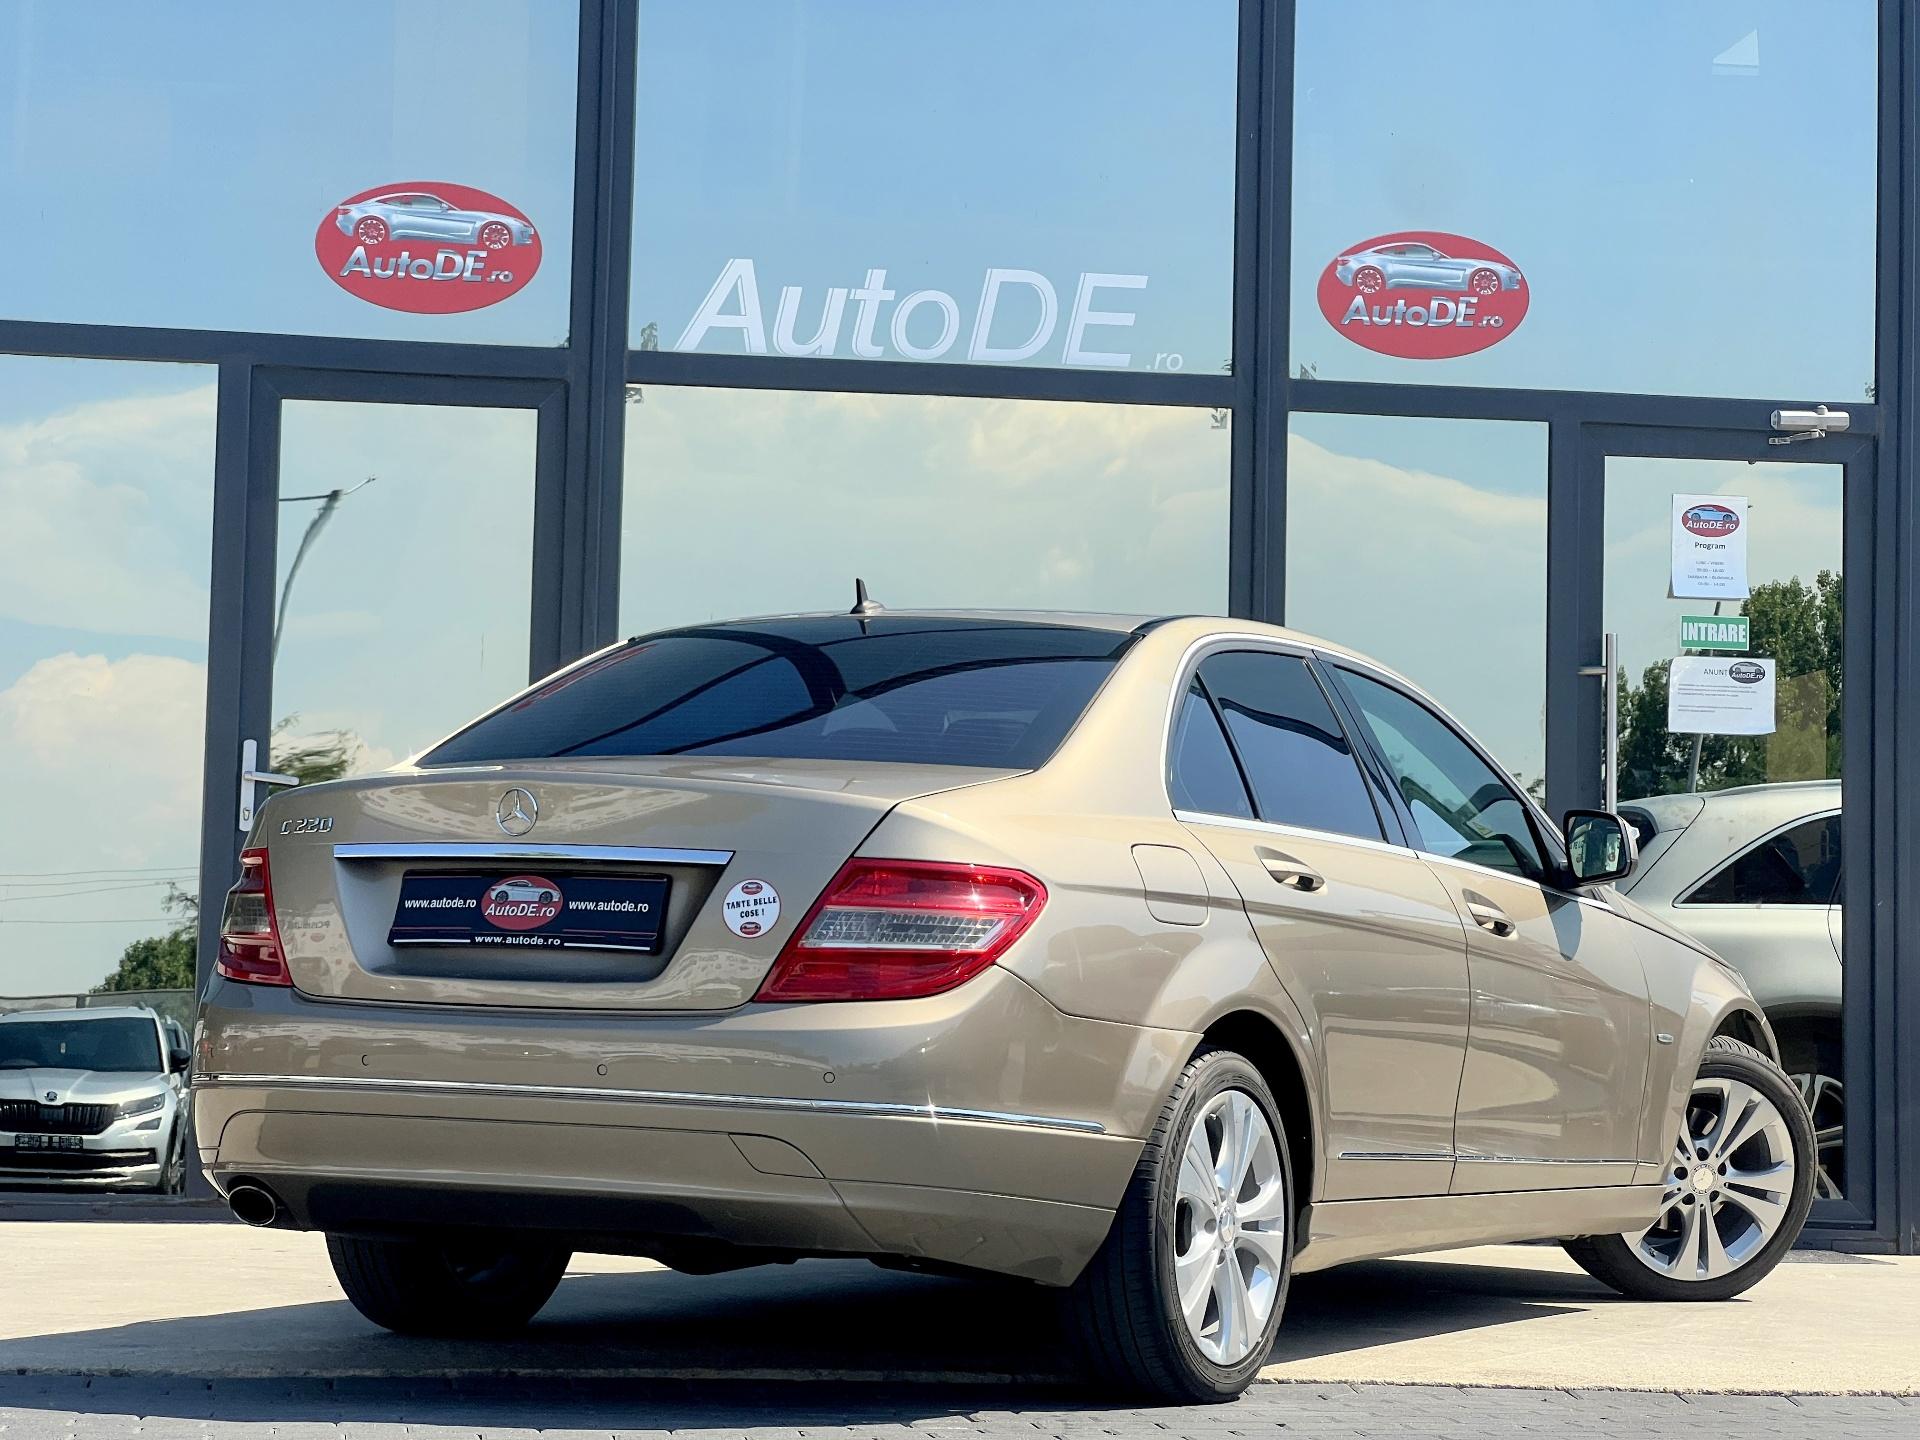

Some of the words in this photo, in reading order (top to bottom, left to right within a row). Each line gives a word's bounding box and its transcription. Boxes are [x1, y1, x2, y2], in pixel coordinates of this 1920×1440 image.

[1685, 520, 1736, 530] AutoDE.ro
[1694, 541, 1726, 551] Program
[1682, 622, 1746, 642] INTRARE
[280, 819, 293, 835] C
[293, 817, 333, 833] 220
[404, 897, 477, 909] www.autode.ro
[568, 899, 649, 913] www.autode.ro
[726, 900, 751, 910] TANTE
[753, 897, 777, 906] BELLE
[484, 903, 556, 917] AutoDE.ro
[740, 909, 759, 918] COSE
[474, 935, 561, 946] www.autode.ro
